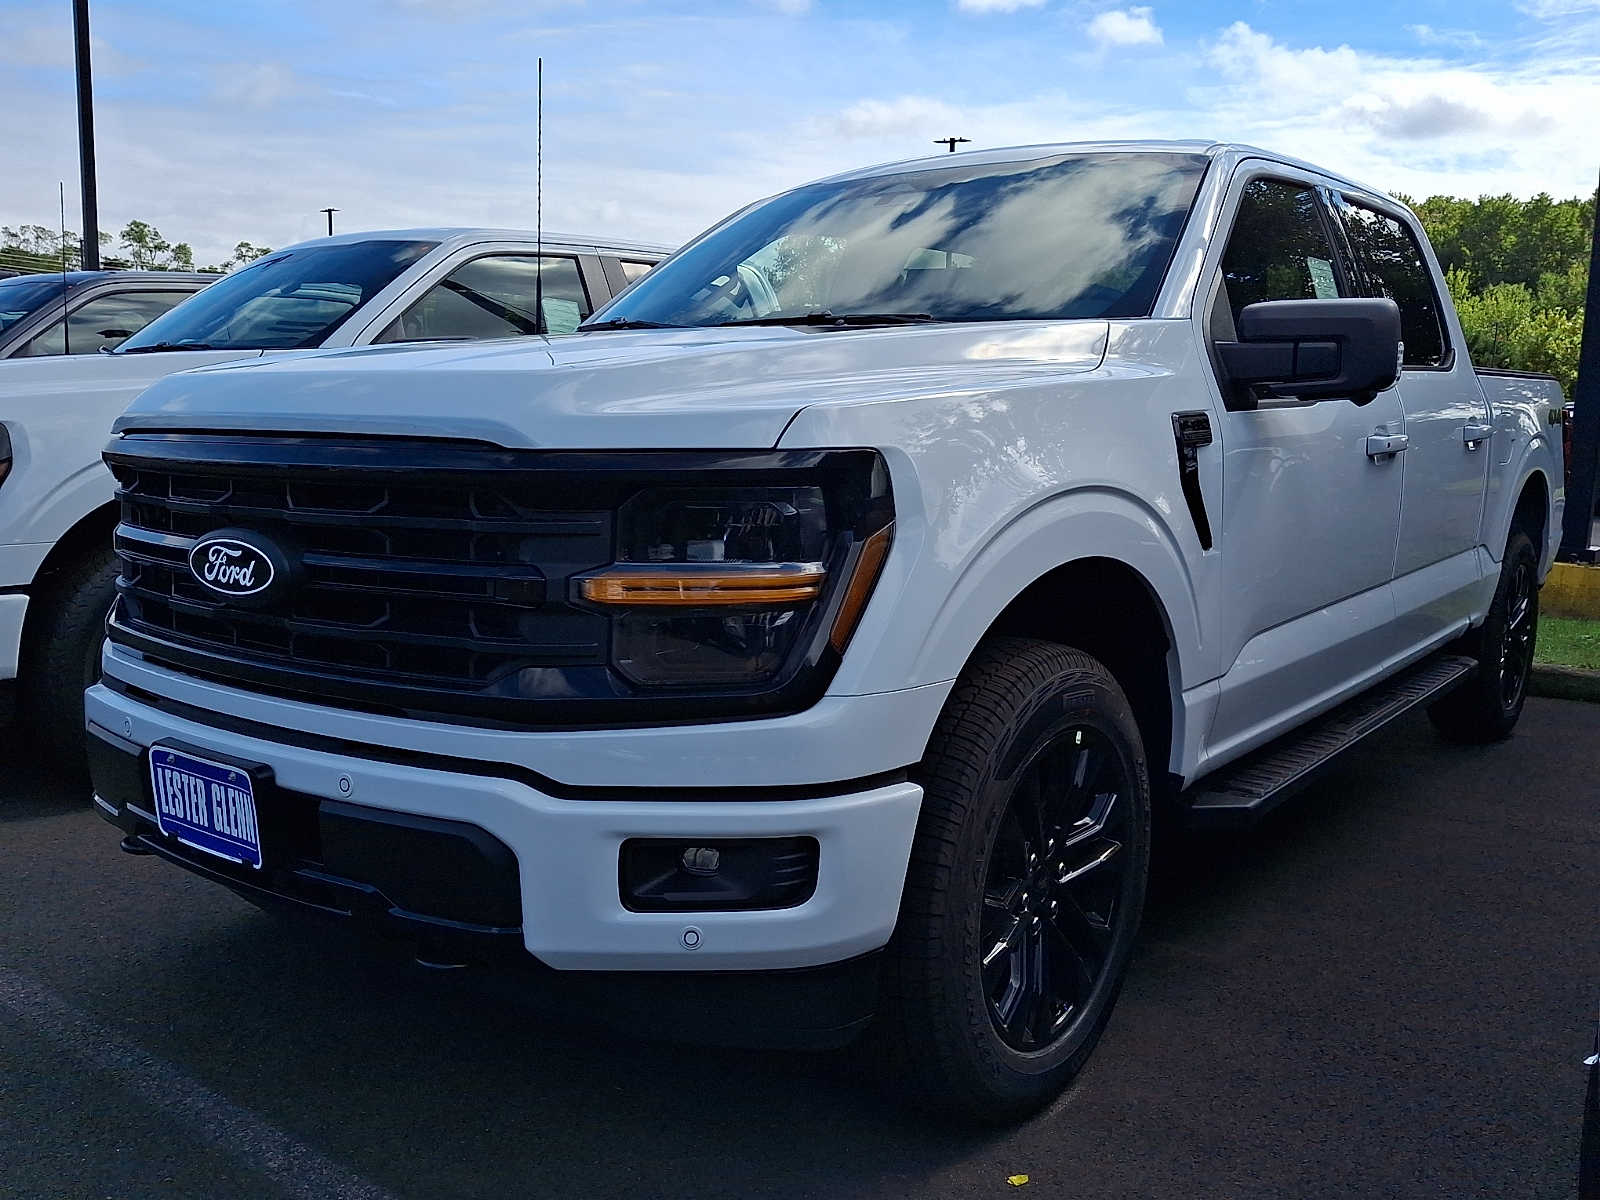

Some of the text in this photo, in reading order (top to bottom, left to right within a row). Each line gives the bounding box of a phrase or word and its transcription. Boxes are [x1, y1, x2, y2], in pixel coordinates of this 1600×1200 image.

[204, 545, 255, 587] Ford
[156, 767, 256, 844] LESTER GLENN
